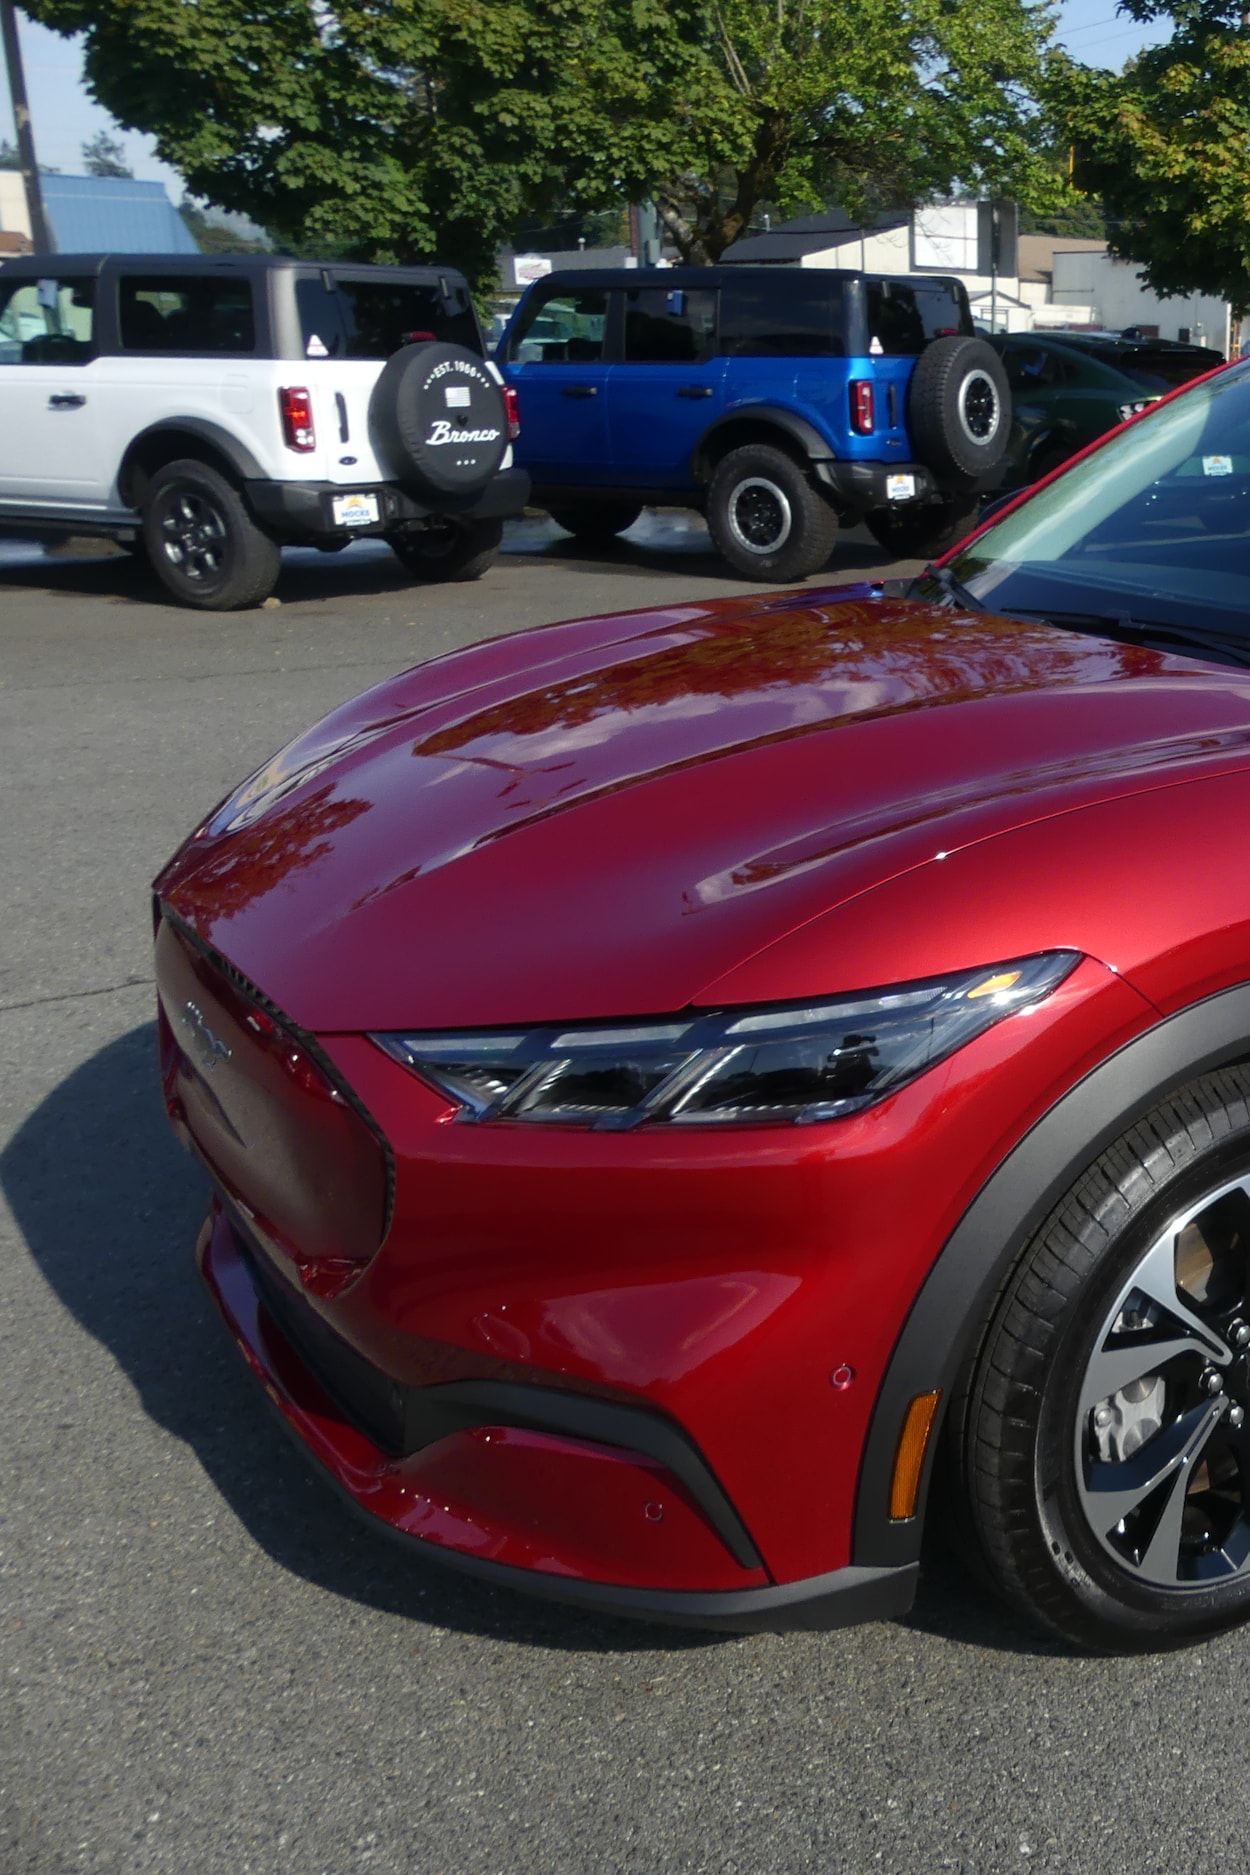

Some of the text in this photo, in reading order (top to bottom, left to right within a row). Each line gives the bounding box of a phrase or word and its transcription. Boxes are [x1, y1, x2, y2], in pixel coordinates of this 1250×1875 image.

[433, 360, 477, 378] EST. 1966
[425, 420, 501, 446] Bronco
